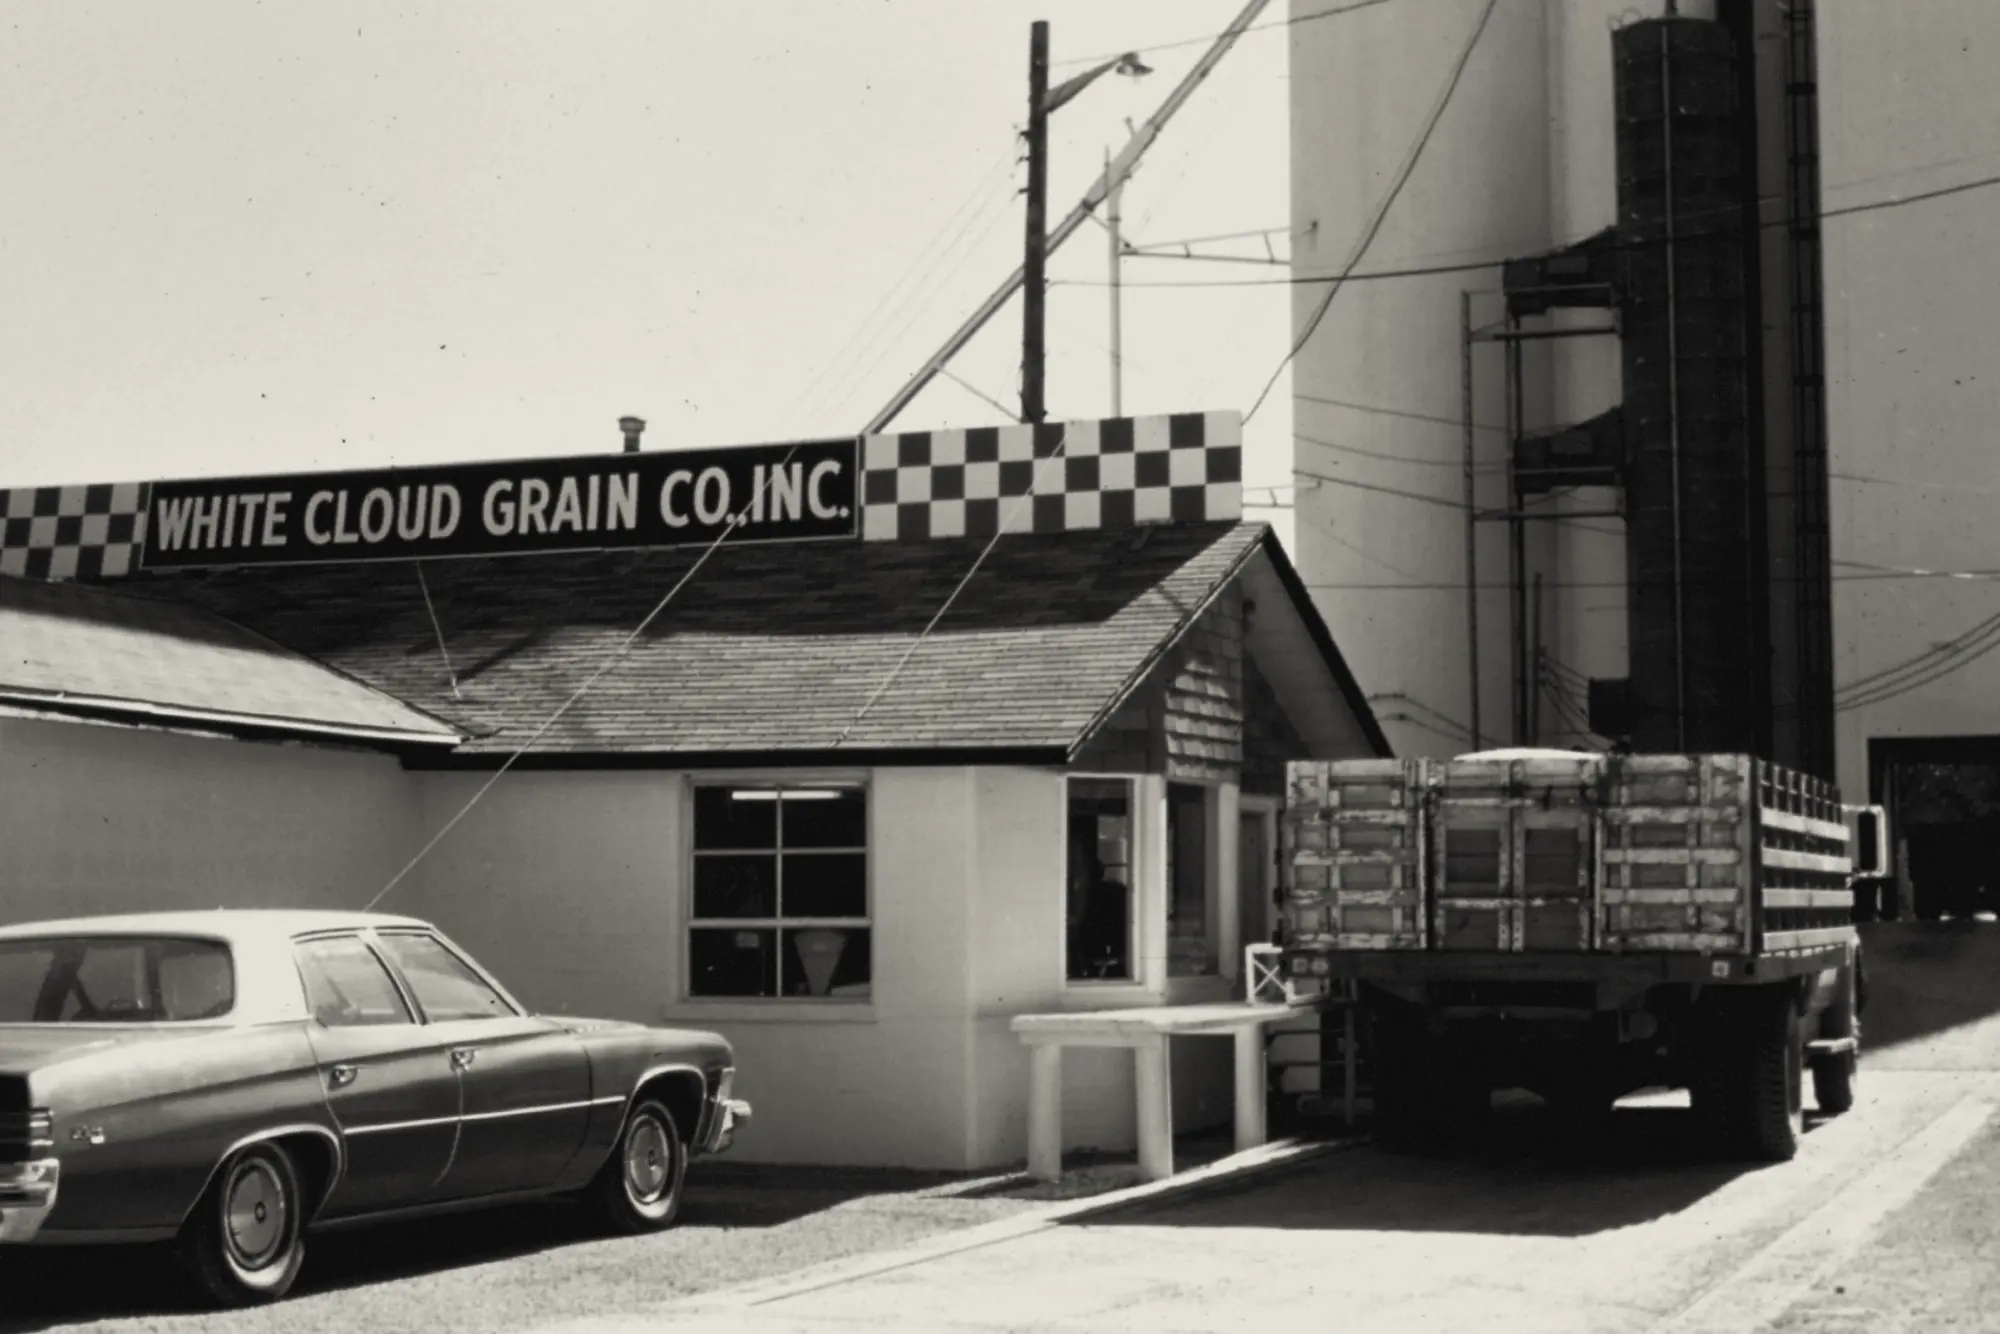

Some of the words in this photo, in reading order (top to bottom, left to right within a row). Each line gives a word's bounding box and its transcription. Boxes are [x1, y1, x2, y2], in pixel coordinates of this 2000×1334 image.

[159, 492, 292, 550] WHITE
[304, 484, 461, 544] CLOUD
[483, 472, 639, 537] GRAIN
